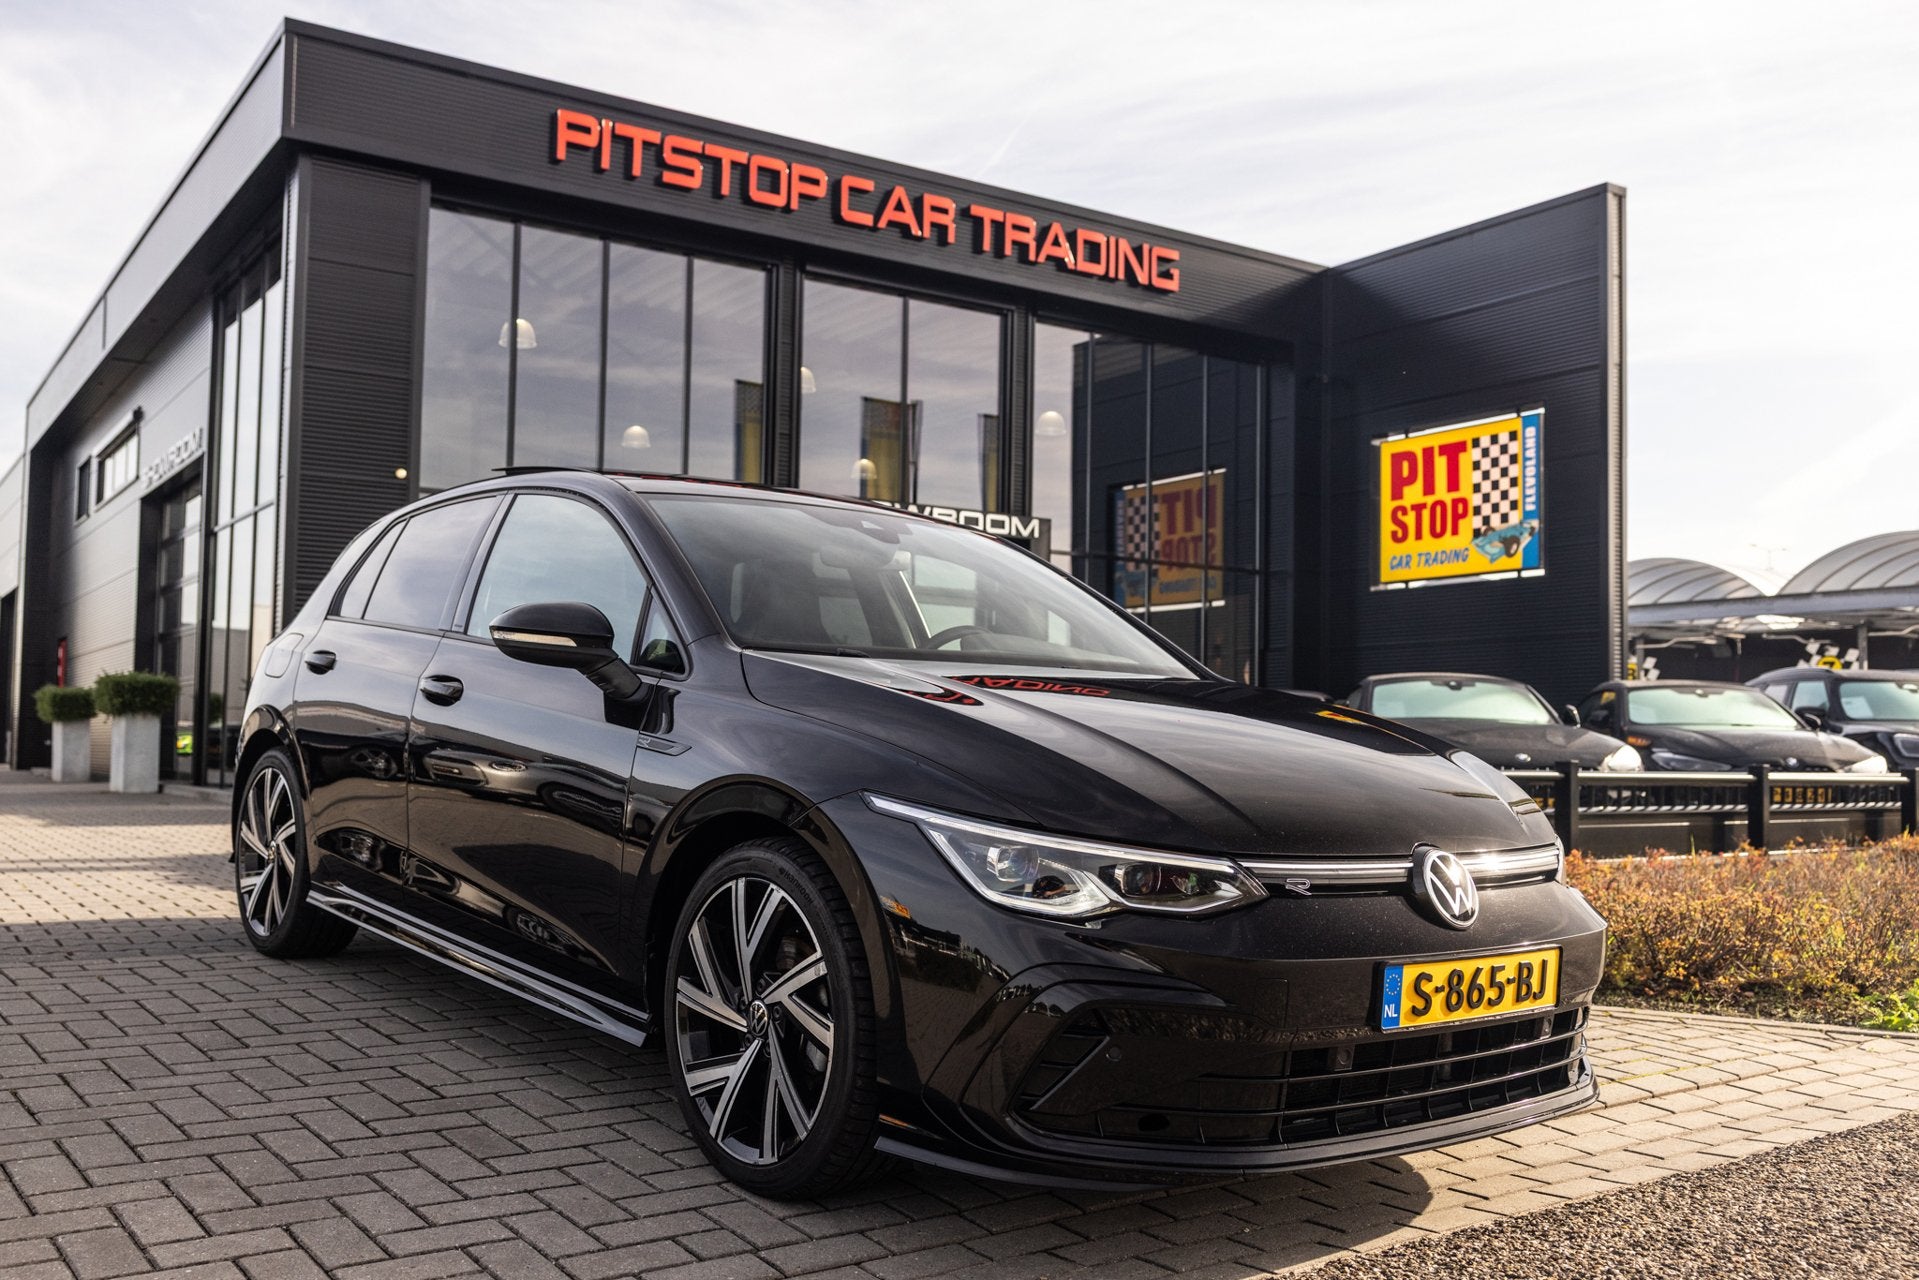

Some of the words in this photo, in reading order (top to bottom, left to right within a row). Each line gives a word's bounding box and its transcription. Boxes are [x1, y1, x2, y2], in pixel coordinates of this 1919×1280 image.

[555, 109, 828, 211] PITSTOP
[839, 174, 956, 244] CAR
[968, 203, 1180, 292] TRADING
[1391, 441, 1467, 501] PIT
[1390, 497, 1469, 544] STOP
[1389, 554, 1412, 571] CAR
[1416, 547, 1470, 568] TRADING
[1384, 1003, 1398, 1018] NL
[1411, 958, 1549, 1017] S-865-BJ
